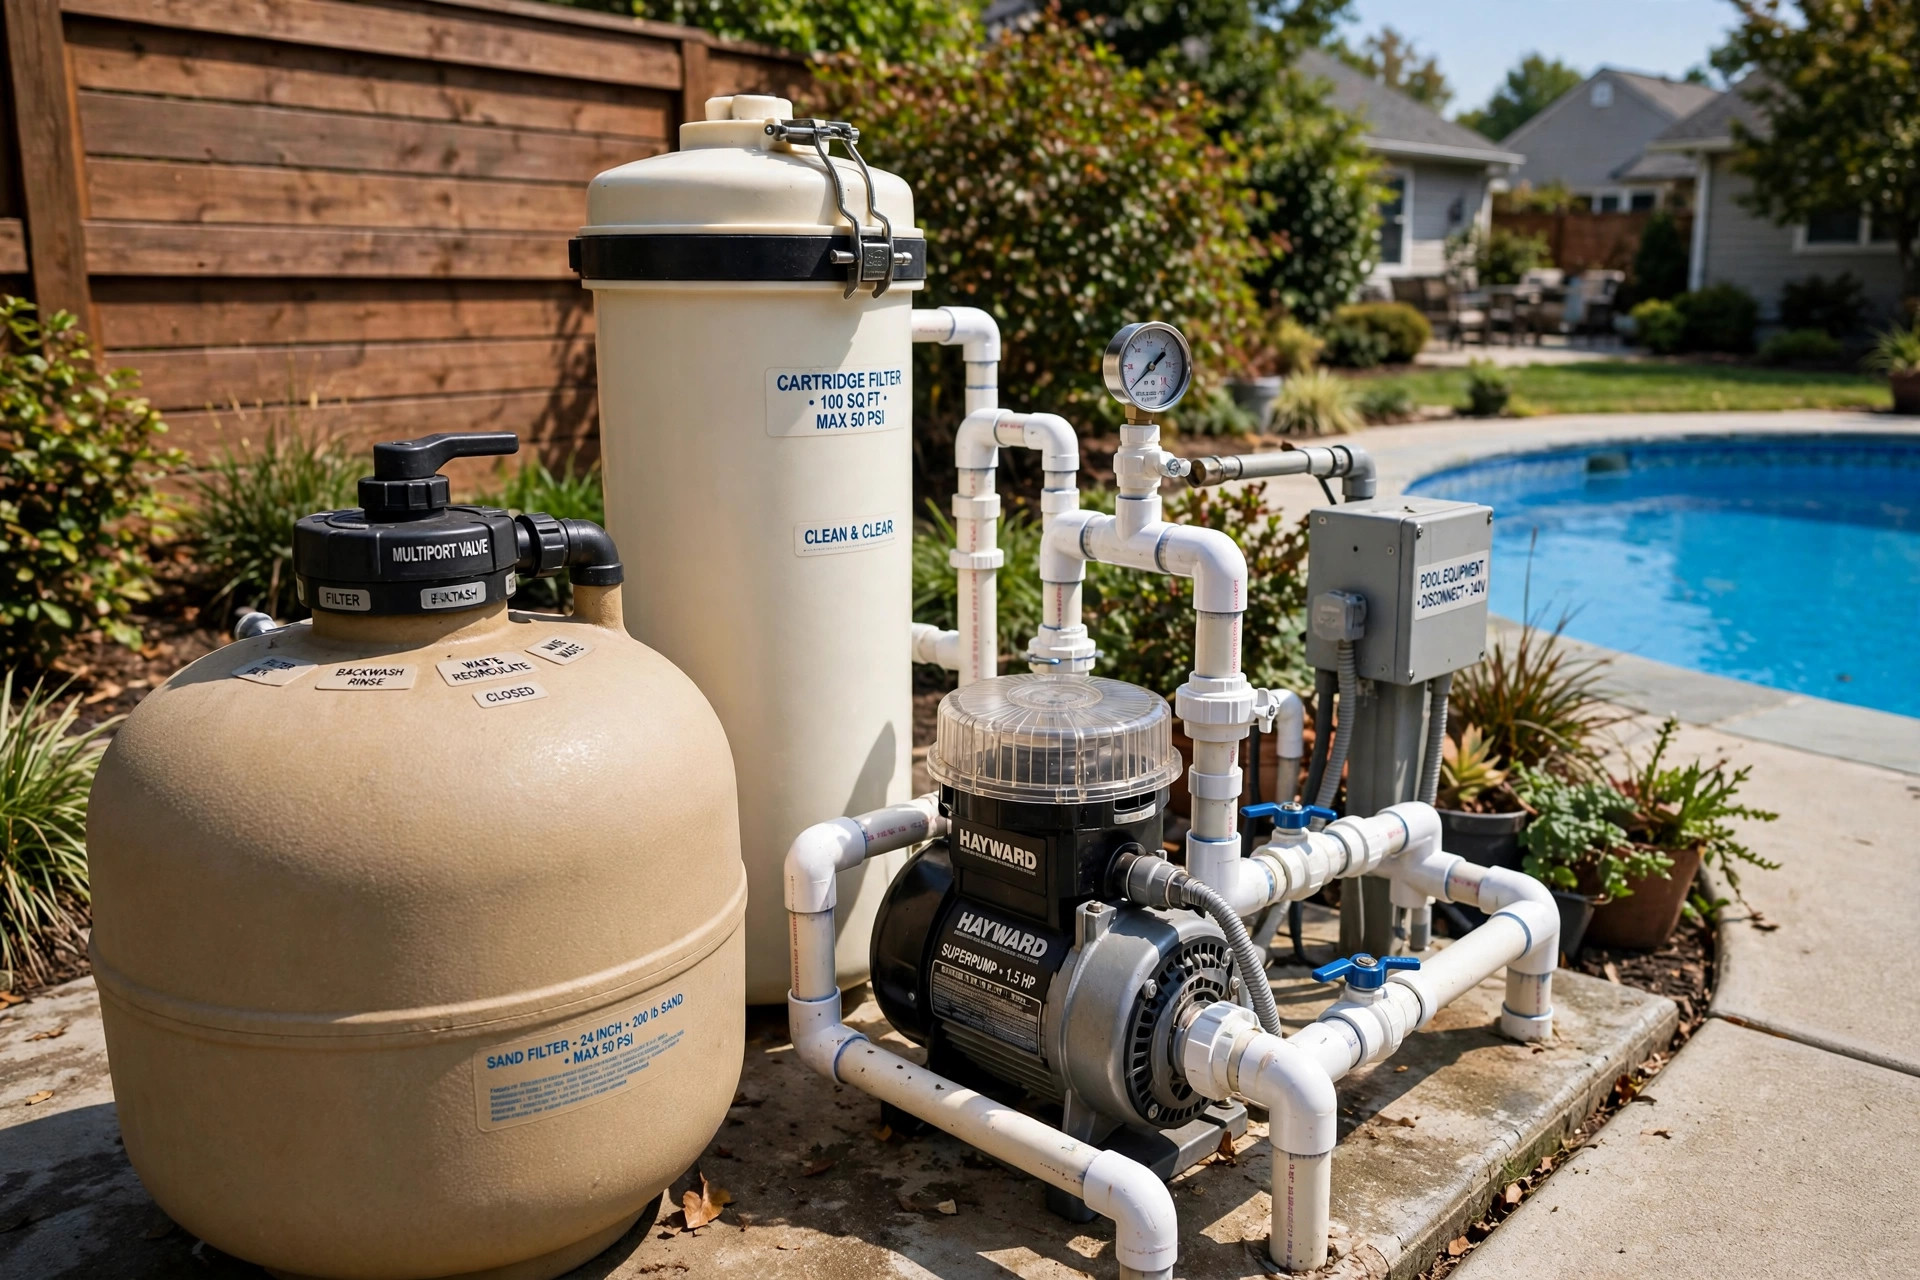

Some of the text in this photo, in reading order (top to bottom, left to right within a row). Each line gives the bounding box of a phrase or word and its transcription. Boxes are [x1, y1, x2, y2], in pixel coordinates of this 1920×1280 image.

[777, 370, 901, 391] CARTRIDGE FILTER
[821, 391, 880, 409] 100 SQ FT
[816, 410, 885, 429] MAX 50 PSI
[804, 519, 893, 544] CLEAN & CLEAR
[392, 538, 489, 562] MULTIPORT VALVE
[1421, 569, 1441, 590] POOL
[325, 591, 361, 606] FILTER
[335, 668, 405, 677] BACKWASH
[347, 677, 386, 686] RINSE
[486, 686, 535, 702] CLOSED
[960, 828, 1037, 870] HAYWARD
[956, 911, 1048, 959] HAYWARD
[941, 943, 998, 975] SUPERPUMP
[1006, 968, 1021, 984] 1.5
[1021, 973, 1036, 989] HP
[487, 1051, 524, 1069] SAND
[527, 1040, 569, 1061] FILTER
[580, 1032, 594, 1047] 24
[596, 1022, 622, 1043] INCH
[632, 1011, 648, 1028] 200
[661, 993, 684, 1014] SAND
[574, 1033, 634, 1065] MAX 50 PSI
